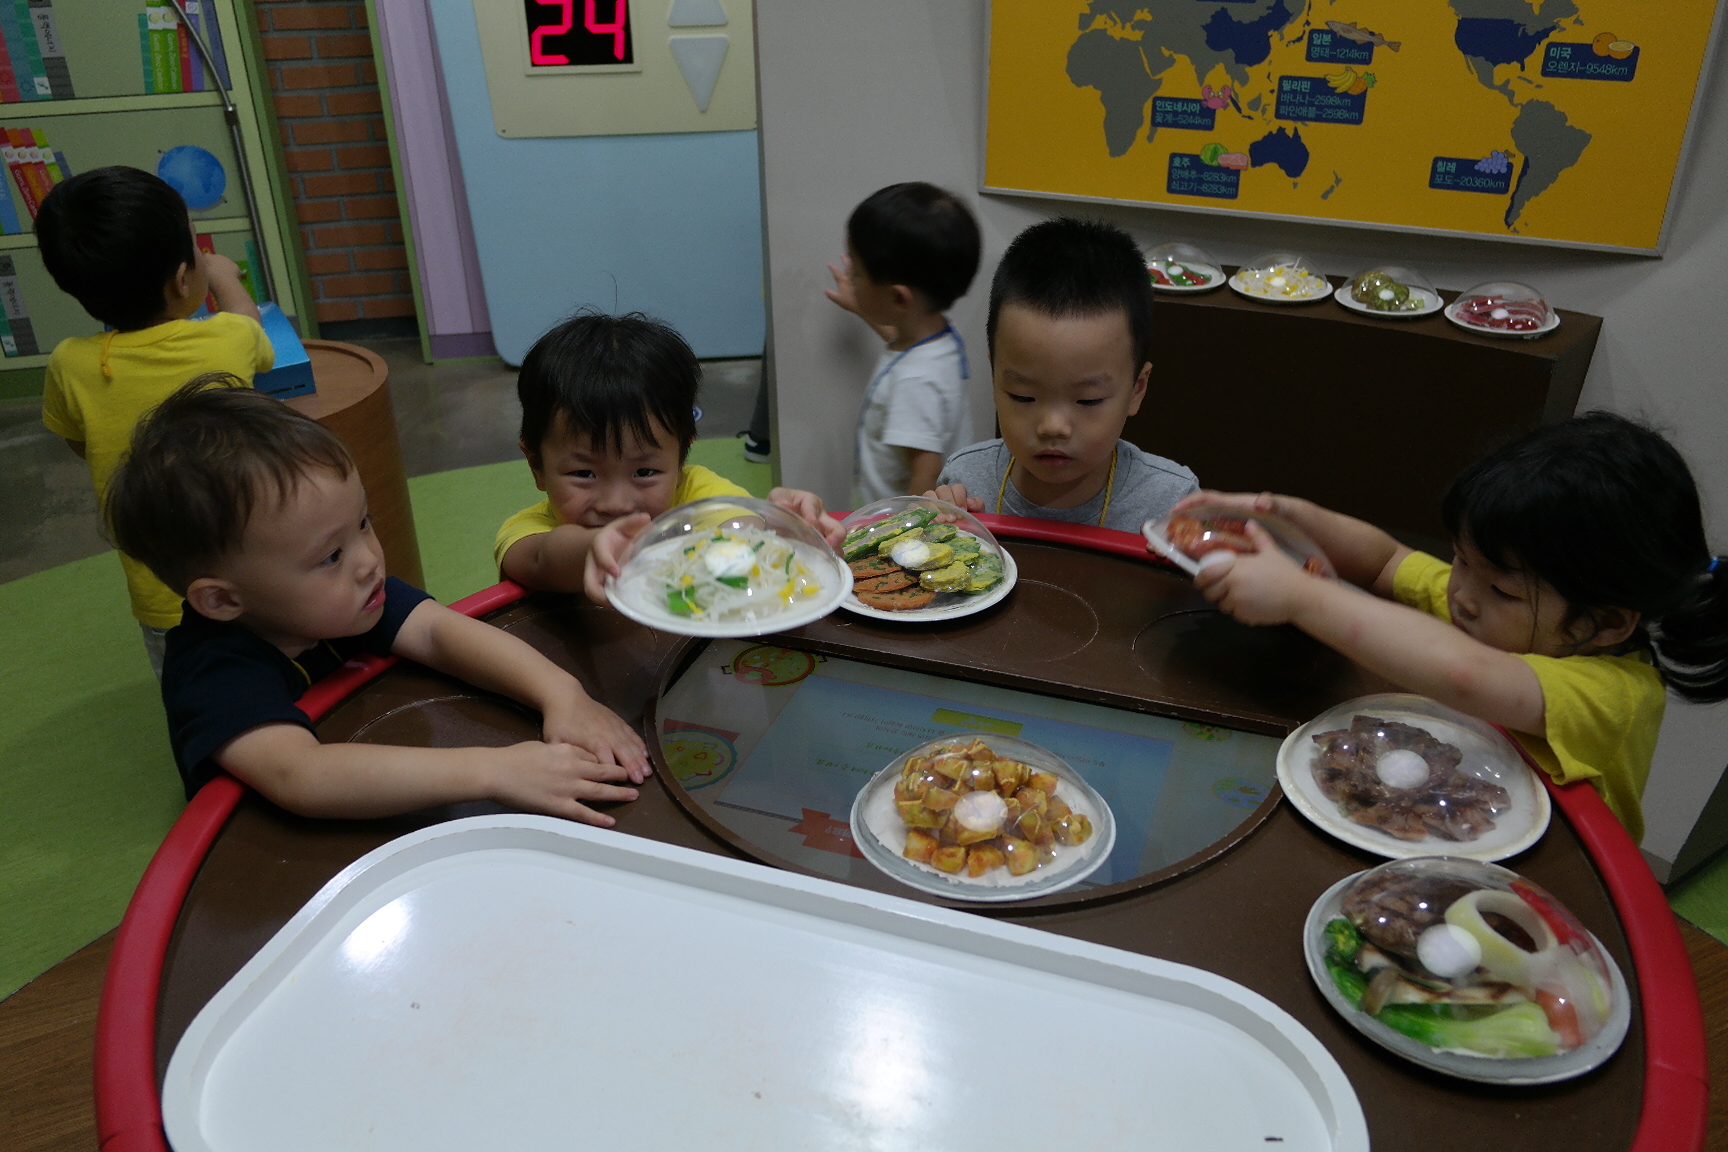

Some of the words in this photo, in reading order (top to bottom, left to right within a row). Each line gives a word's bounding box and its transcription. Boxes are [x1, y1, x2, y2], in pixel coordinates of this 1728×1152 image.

[531, 0, 626, 65] 24
[1312, 33, 1332, 45] 일본
[1549, 47, 1571, 59] 미국
[1282, 79, 1311, 92] 필리핀
[1156, 99, 1200, 112] 인도네시아
[1172, 157, 1191, 168] 호주
[1436, 160, 1456, 173] 칠레
